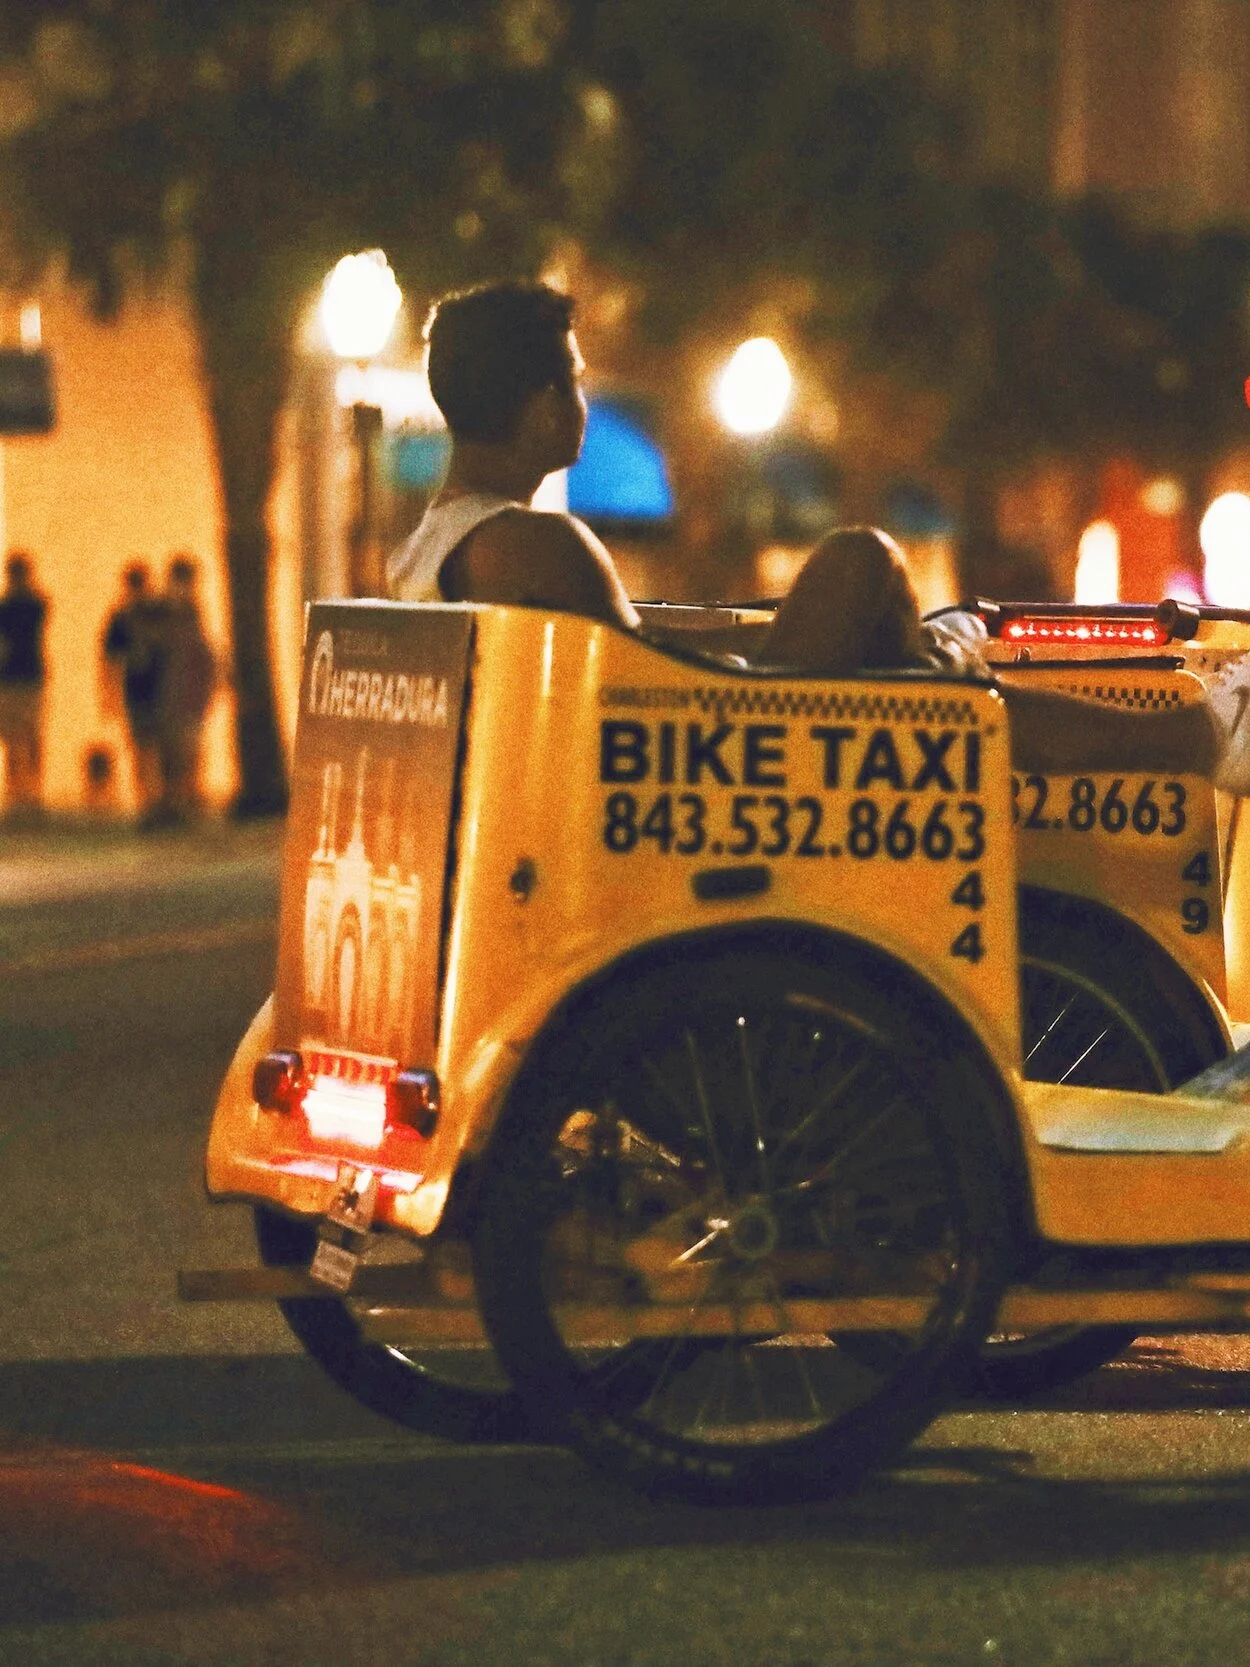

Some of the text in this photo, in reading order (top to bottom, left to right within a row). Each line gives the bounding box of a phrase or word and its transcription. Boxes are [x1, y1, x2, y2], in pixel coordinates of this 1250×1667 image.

[601, 720, 981, 792] BIKE TAXI
[604, 792, 985, 862] 843.532.8663
